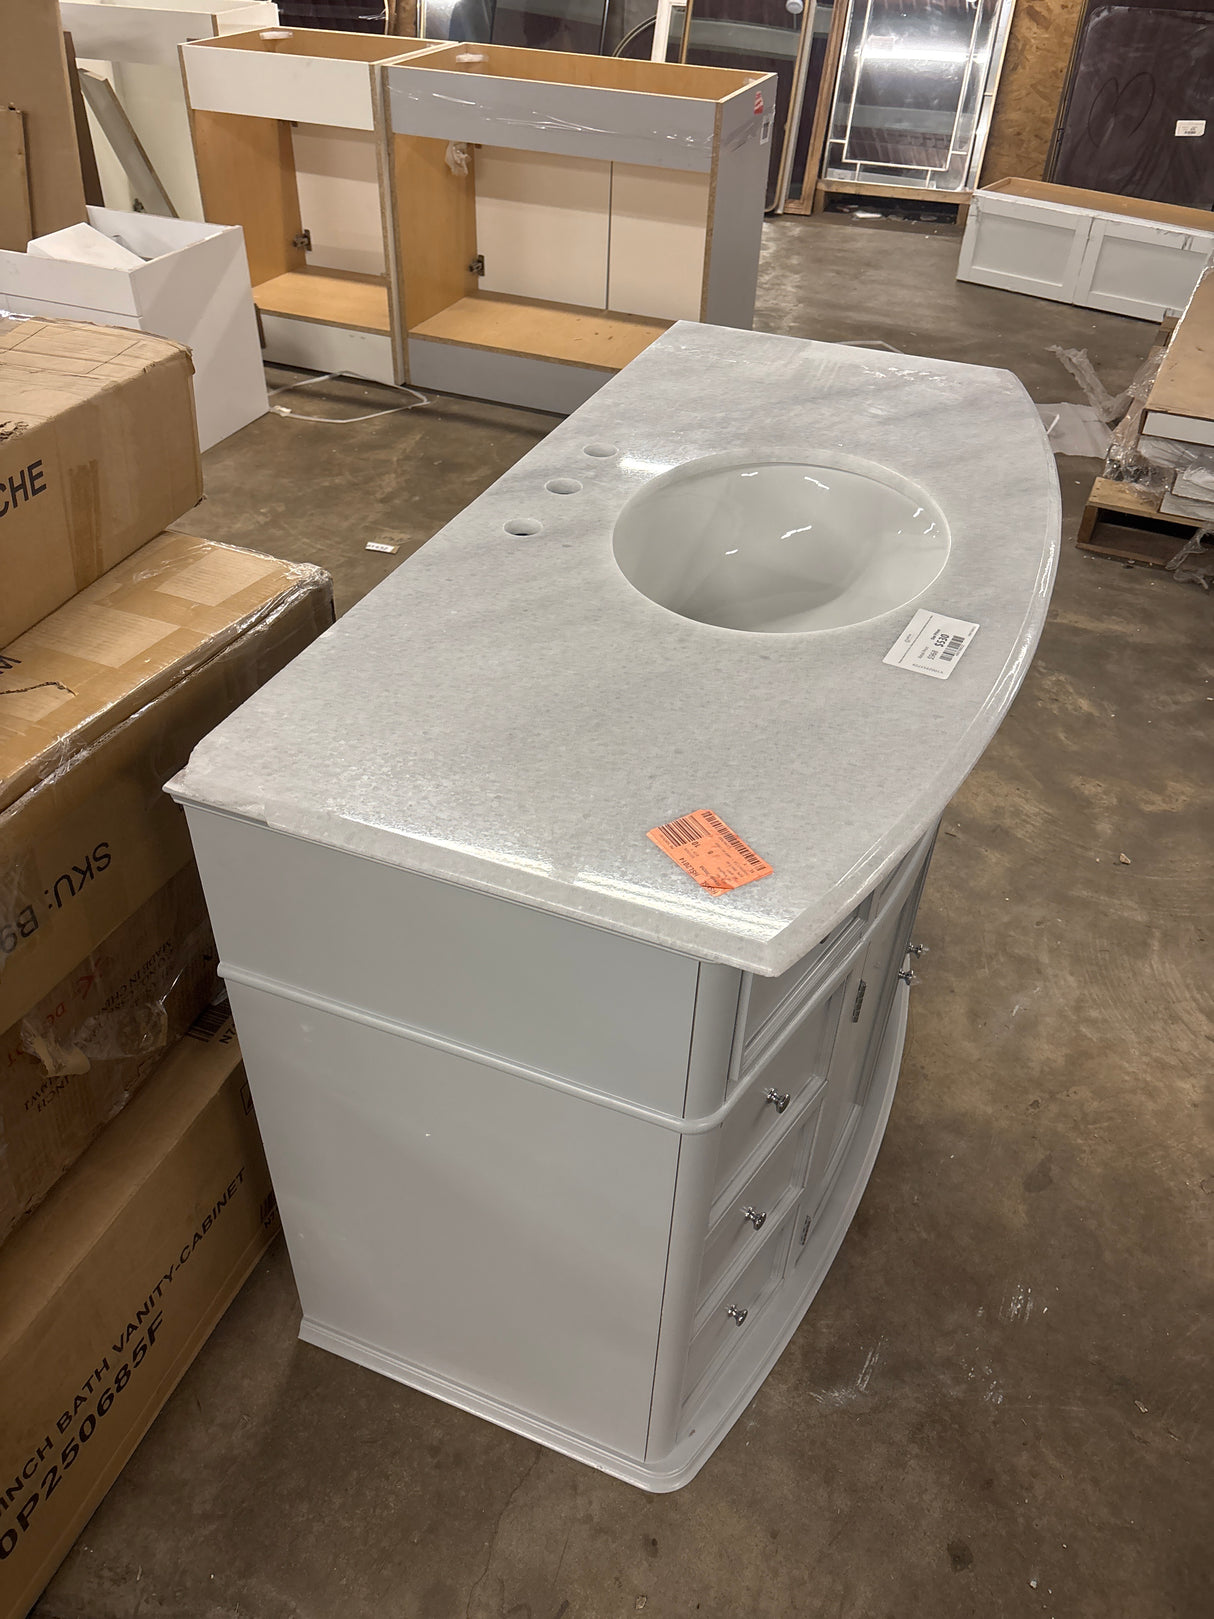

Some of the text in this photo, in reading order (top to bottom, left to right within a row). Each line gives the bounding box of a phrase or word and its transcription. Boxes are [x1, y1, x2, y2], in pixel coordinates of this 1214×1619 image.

[44, 842, 112, 909] SKU:
[0, 1167, 245, 1512] INCH BATH VANITY-CABINET
